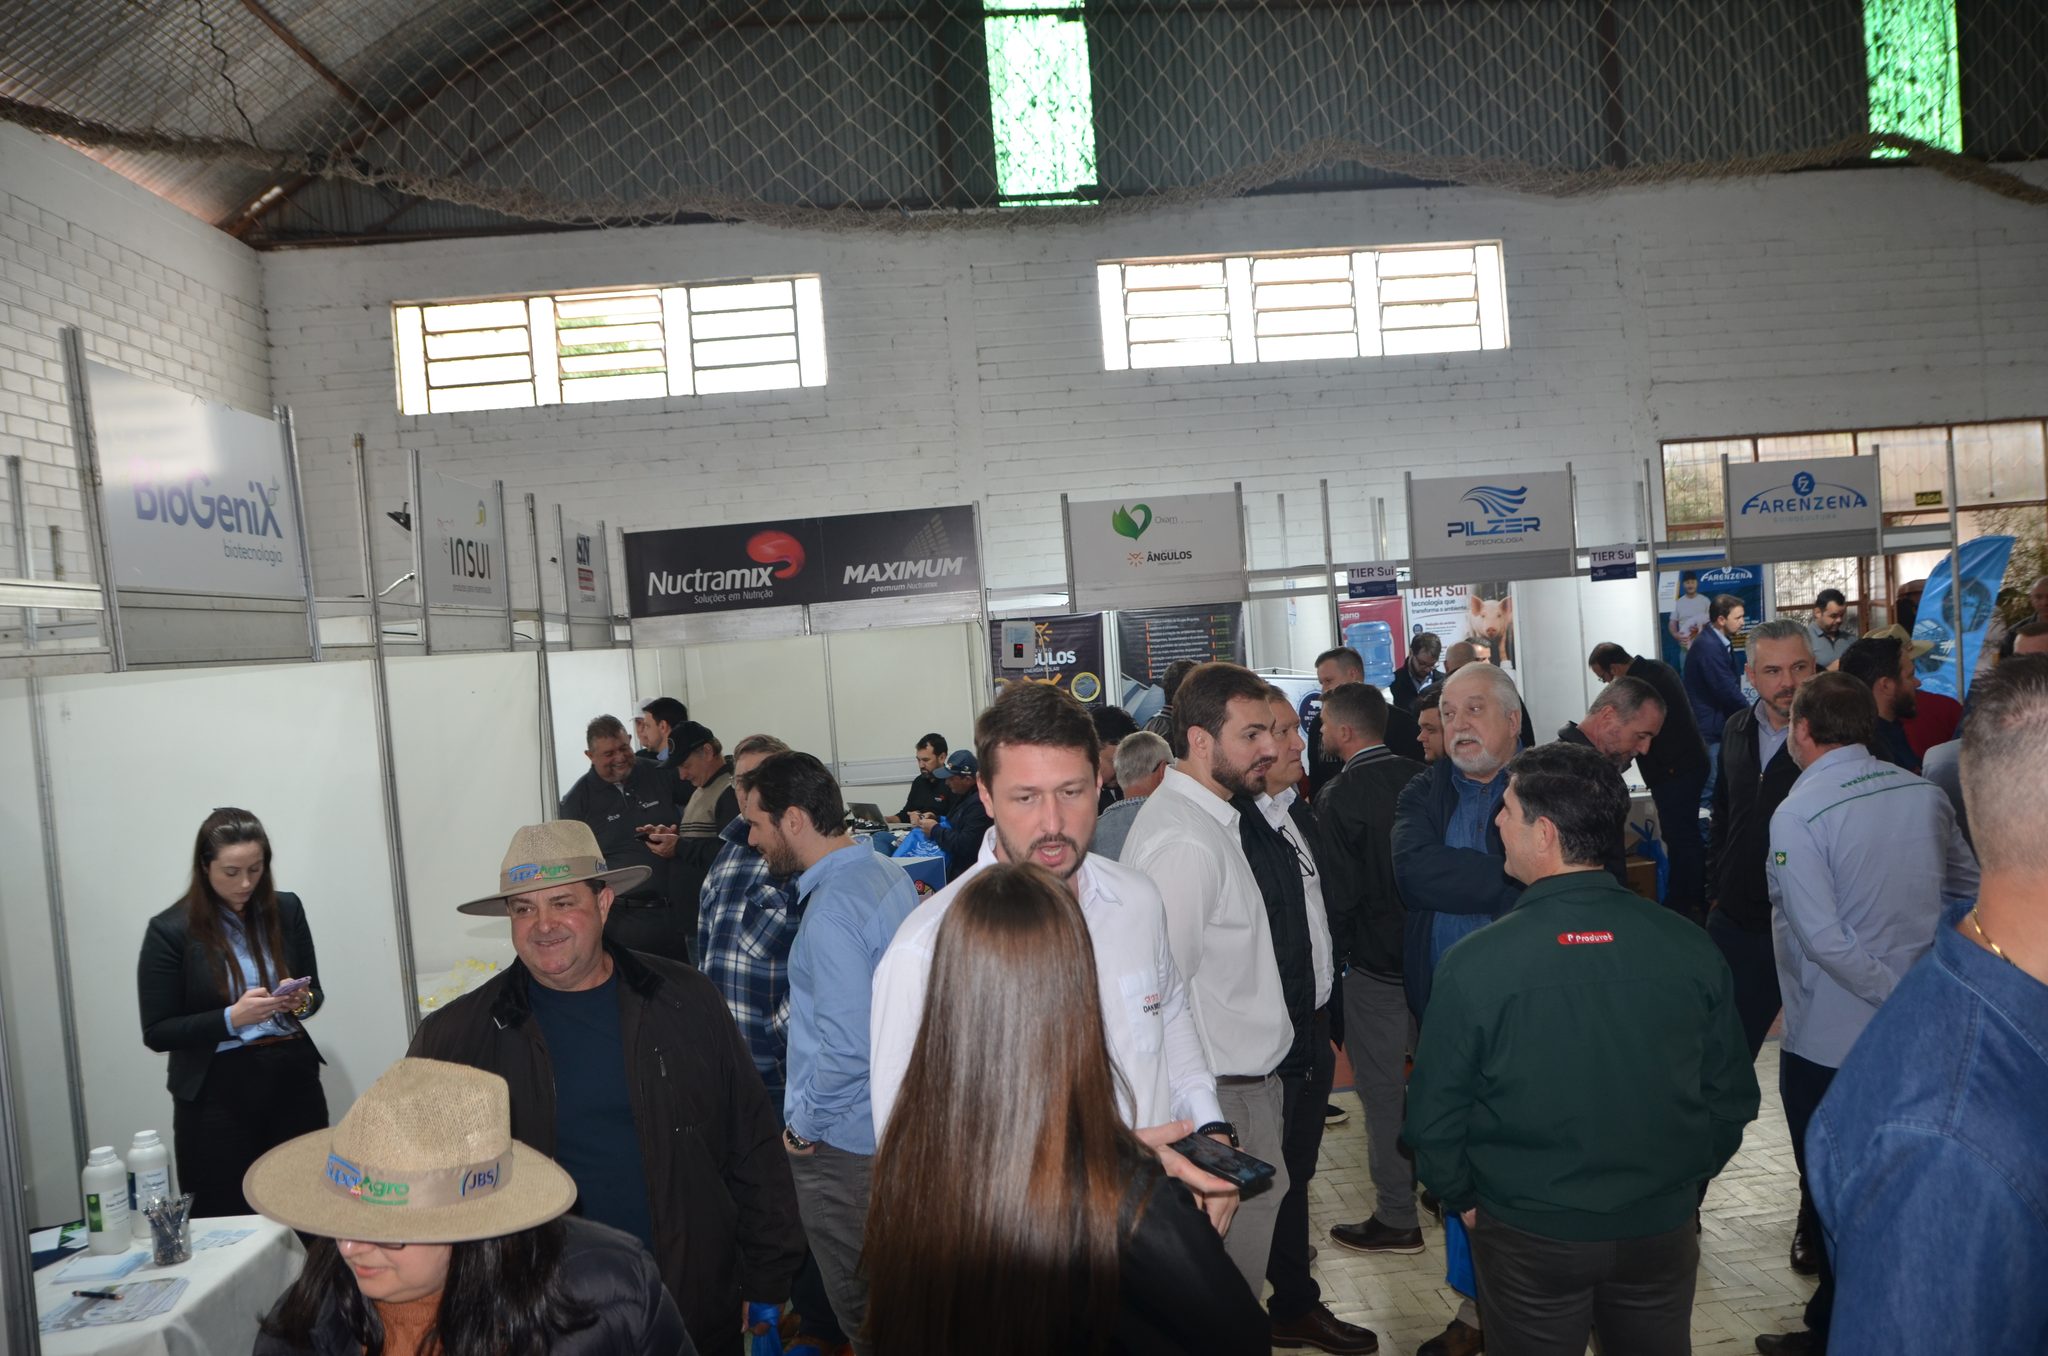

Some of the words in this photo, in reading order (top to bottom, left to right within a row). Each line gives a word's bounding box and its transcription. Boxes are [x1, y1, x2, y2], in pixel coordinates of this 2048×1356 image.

[1741, 494, 1868, 515] FARENZENA
[1448, 516, 1541, 537] PILZER
[1465, 537, 1524, 547] BIOTECNOLOGIA
[223, 539, 284, 568] biotecnologia
[1146, 551, 1193, 562] ÂNGULOS
[1592, 551, 1614, 562] TIER
[1617, 549, 1635, 560] Sui
[842, 556, 964, 585] MAXIMUM
[1349, 567, 1375, 578] TIER
[1377, 565, 1394, 576] Sui
[1701, 571, 1753, 583] FARENZENA
[648, 566, 774, 597] Nuctramix
[871, 583, 906, 595] premium
[694, 593, 726, 605] Soluções
[728, 592, 741, 601] em
[742, 589, 774, 600] Nutrição
